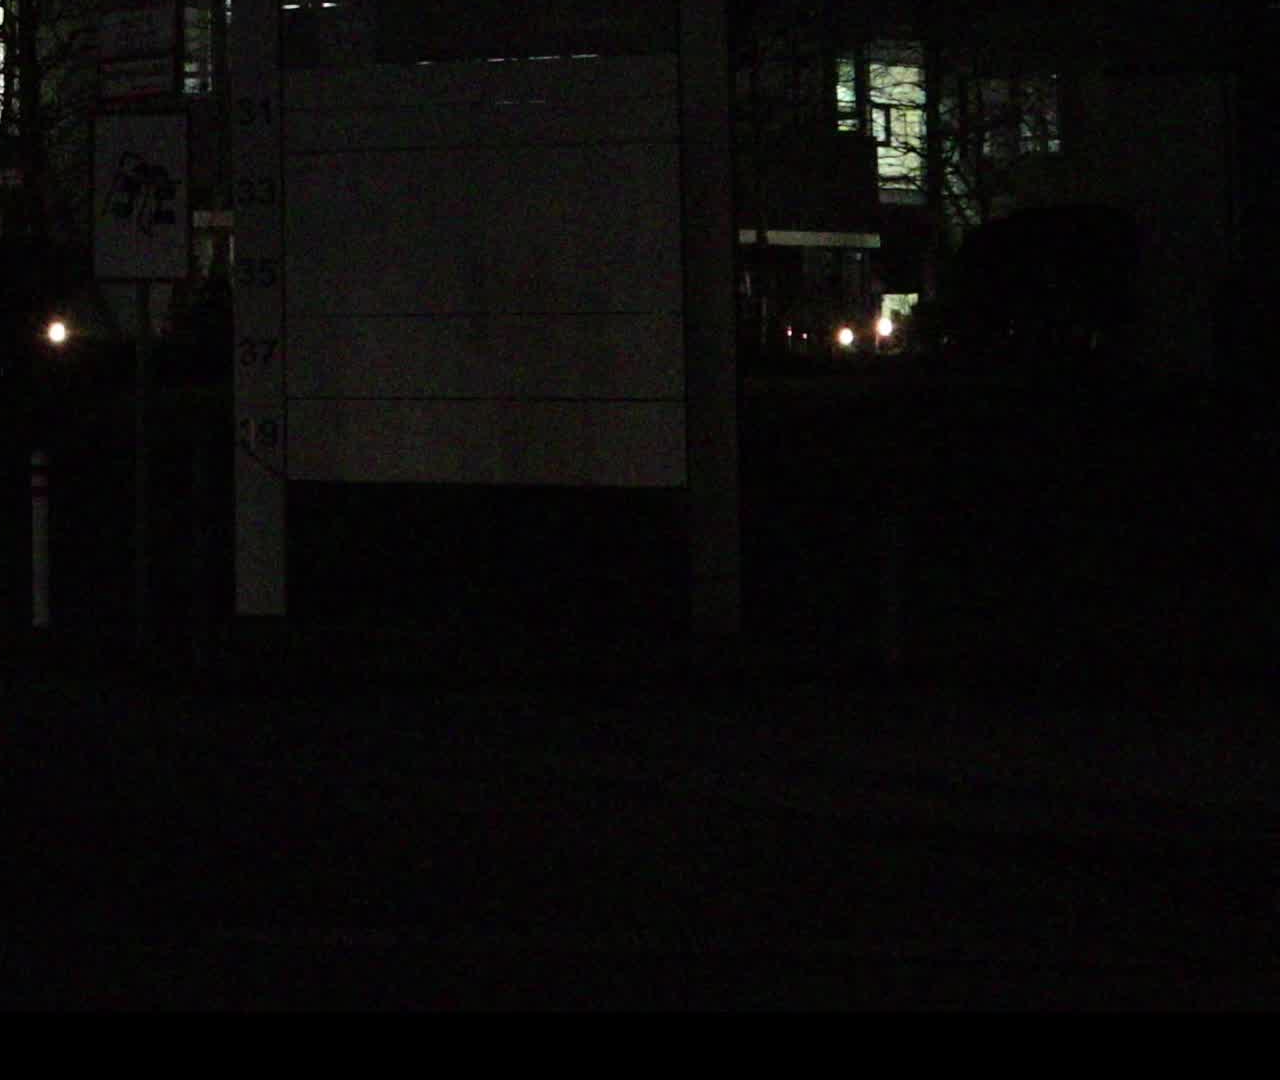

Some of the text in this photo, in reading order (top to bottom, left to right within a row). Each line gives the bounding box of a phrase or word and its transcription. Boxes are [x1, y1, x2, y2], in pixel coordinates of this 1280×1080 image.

[237, 98, 272, 126] 31
[237, 178, 276, 206] 33
[237, 258, 278, 288] 35
[239, 338, 278, 367] 37
